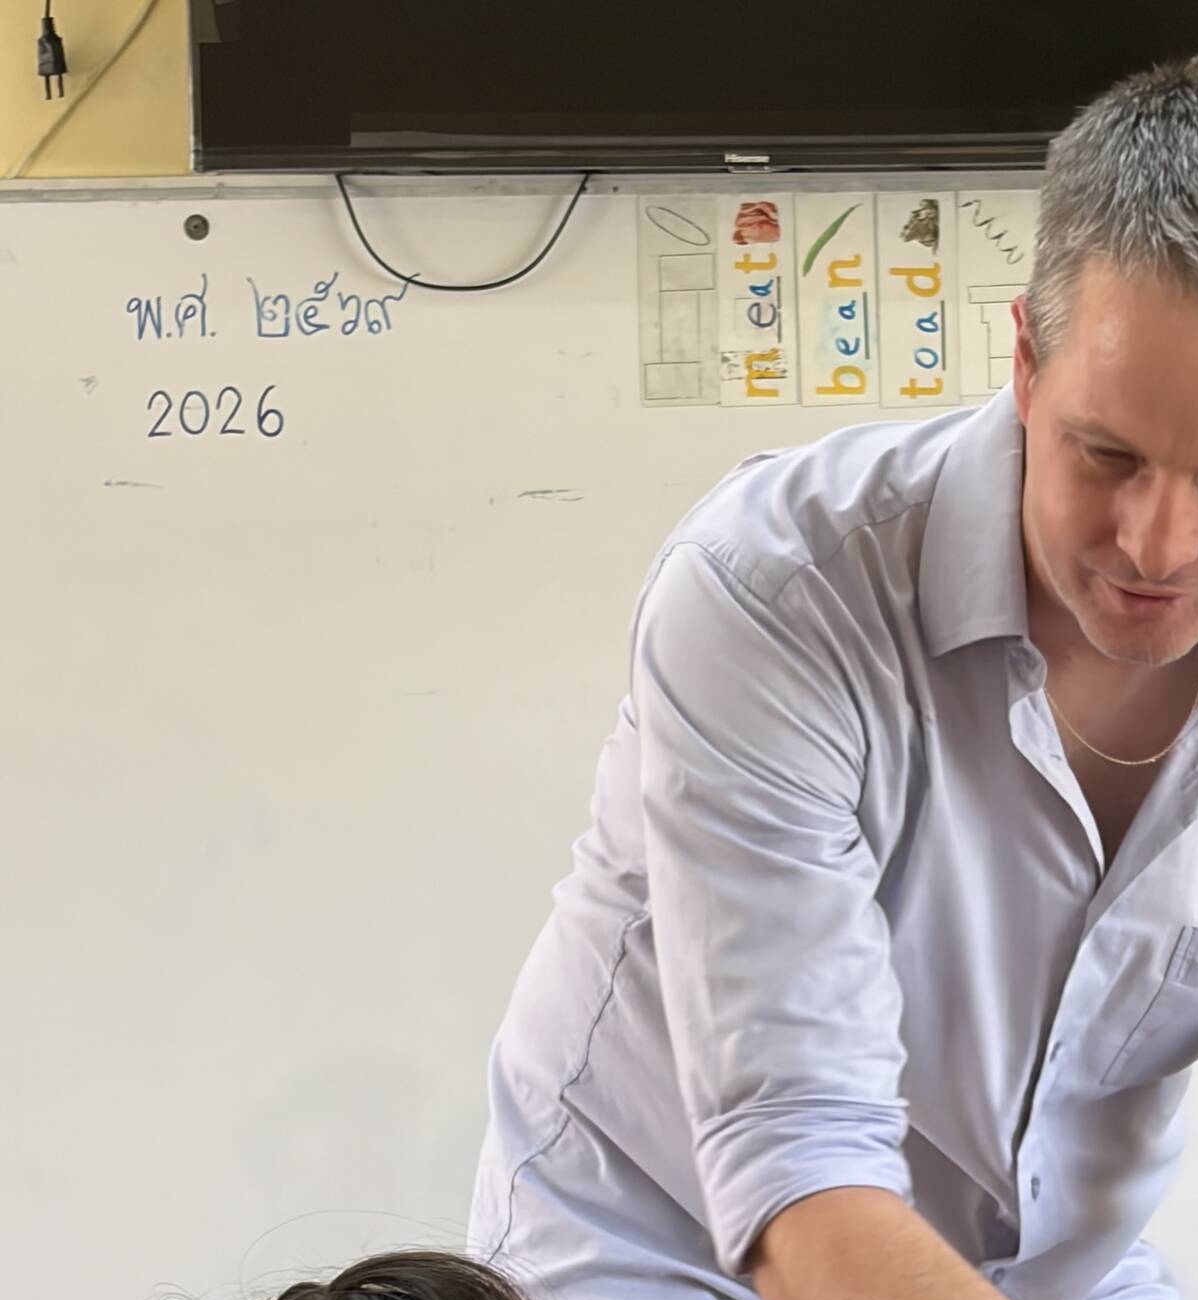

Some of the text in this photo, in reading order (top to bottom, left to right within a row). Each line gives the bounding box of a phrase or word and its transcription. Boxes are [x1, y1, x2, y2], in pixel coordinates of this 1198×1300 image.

[734, 252, 781, 398] meat
[816, 254, 868, 396] bean
[889, 262, 944, 399] toad
[147, 386, 285, 437] 2026
